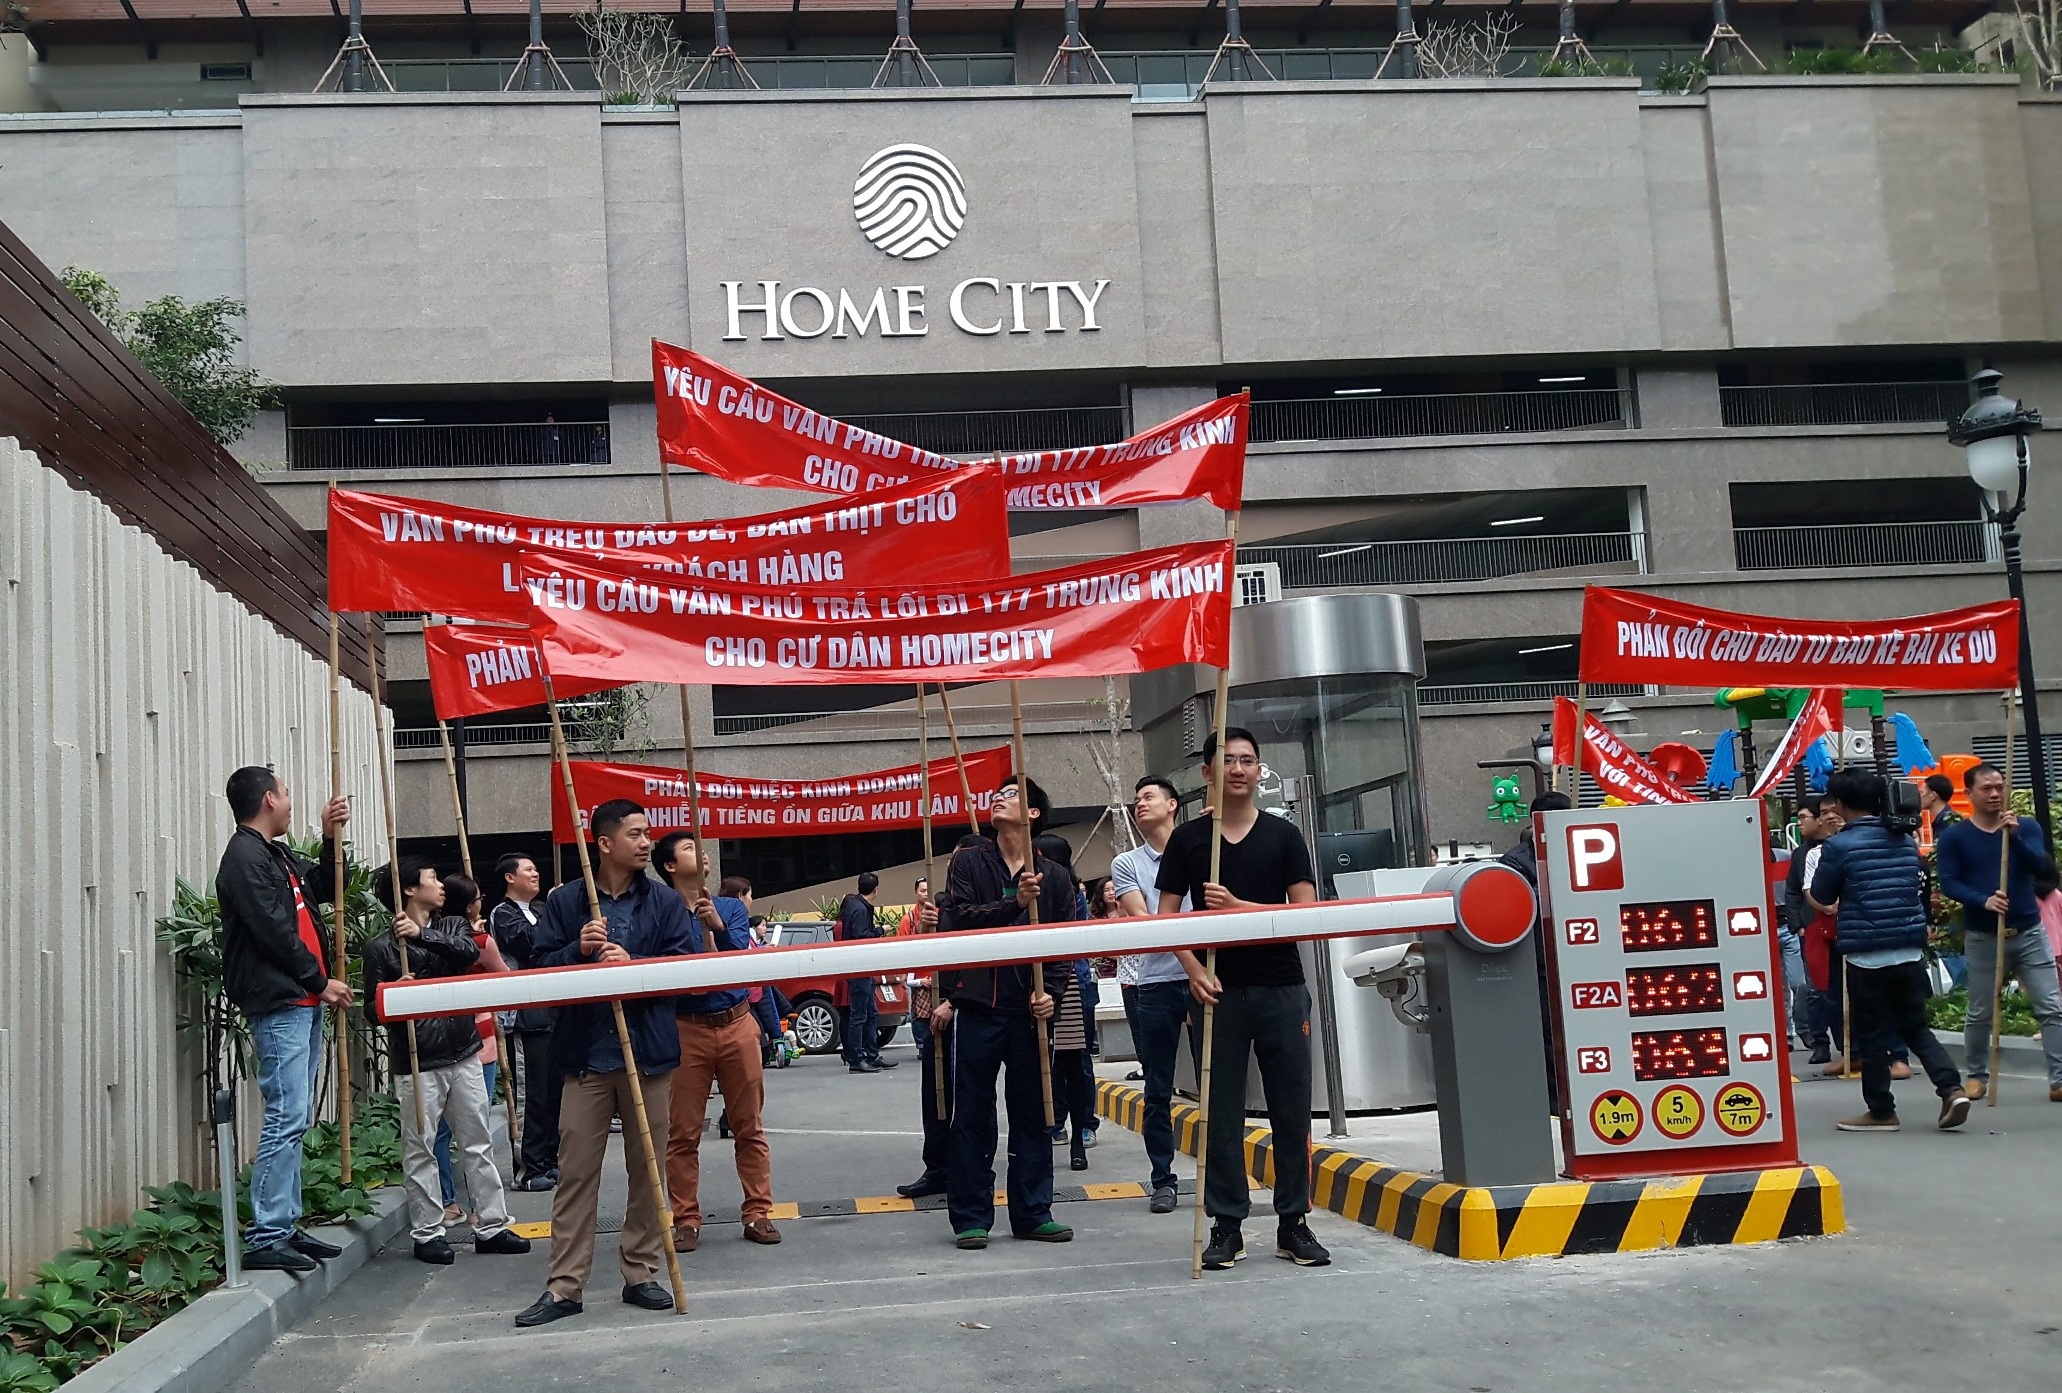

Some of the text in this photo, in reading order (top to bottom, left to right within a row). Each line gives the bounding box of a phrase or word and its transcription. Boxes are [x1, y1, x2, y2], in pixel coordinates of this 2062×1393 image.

[719, 276, 1112, 341] HOME CITY
[663, 365, 712, 406] YÊU
[717, 383, 775, 423] CẦU
[1050, 446, 1096, 471] 177
[1100, 432, 1174, 466] TRUNG
[1180, 415, 1236, 451] KÍNH
[803, 454, 859, 493] CHO
[380, 509, 445, 543] VĂN
[453, 521, 516, 545] PHÚ
[823, 502, 886, 535] THỊT
[896, 485, 957, 525] CHÓ
[758, 549, 844, 586] HÀNG
[527, 562, 1224, 620] YÊU CẦU VĂN PHÚ TRẢ LỐI ĐI 177 TRUNG KÍNH
[704, 629, 1055, 669] CHO CƯ DÂN HOMECITY
[1617, 609, 1671, 658] PHẢN
[1673, 618, 1713, 660] ĐỐI
[1711, 622, 1758, 662] CHỦ
[1938, 632, 1965, 664] XE
[465, 639, 532, 688] PHẢN
[708, 778, 743, 799] ĐỐI
[750, 780, 795, 803] VIỆC
[801, 781, 851, 798] KINH
[856, 773, 922, 795] DOANH
[717, 803, 776, 825] TIẾNG
[782, 802, 811, 824] ỒN
[817, 802, 865, 823] GIỮA
[871, 800, 911, 821] KHU
[1572, 828, 1616, 887] P
[1568, 922, 1596, 941] F2
[1575, 986, 1619, 1005] F2A
[1580, 1051, 1608, 1070] F3
[1599, 1112, 1634, 1125] 1.9m
[1666, 1115, 1692, 1126] km/h
[1672, 1095, 1684, 1113] 5
[1729, 1113, 1752, 1126] 7m
